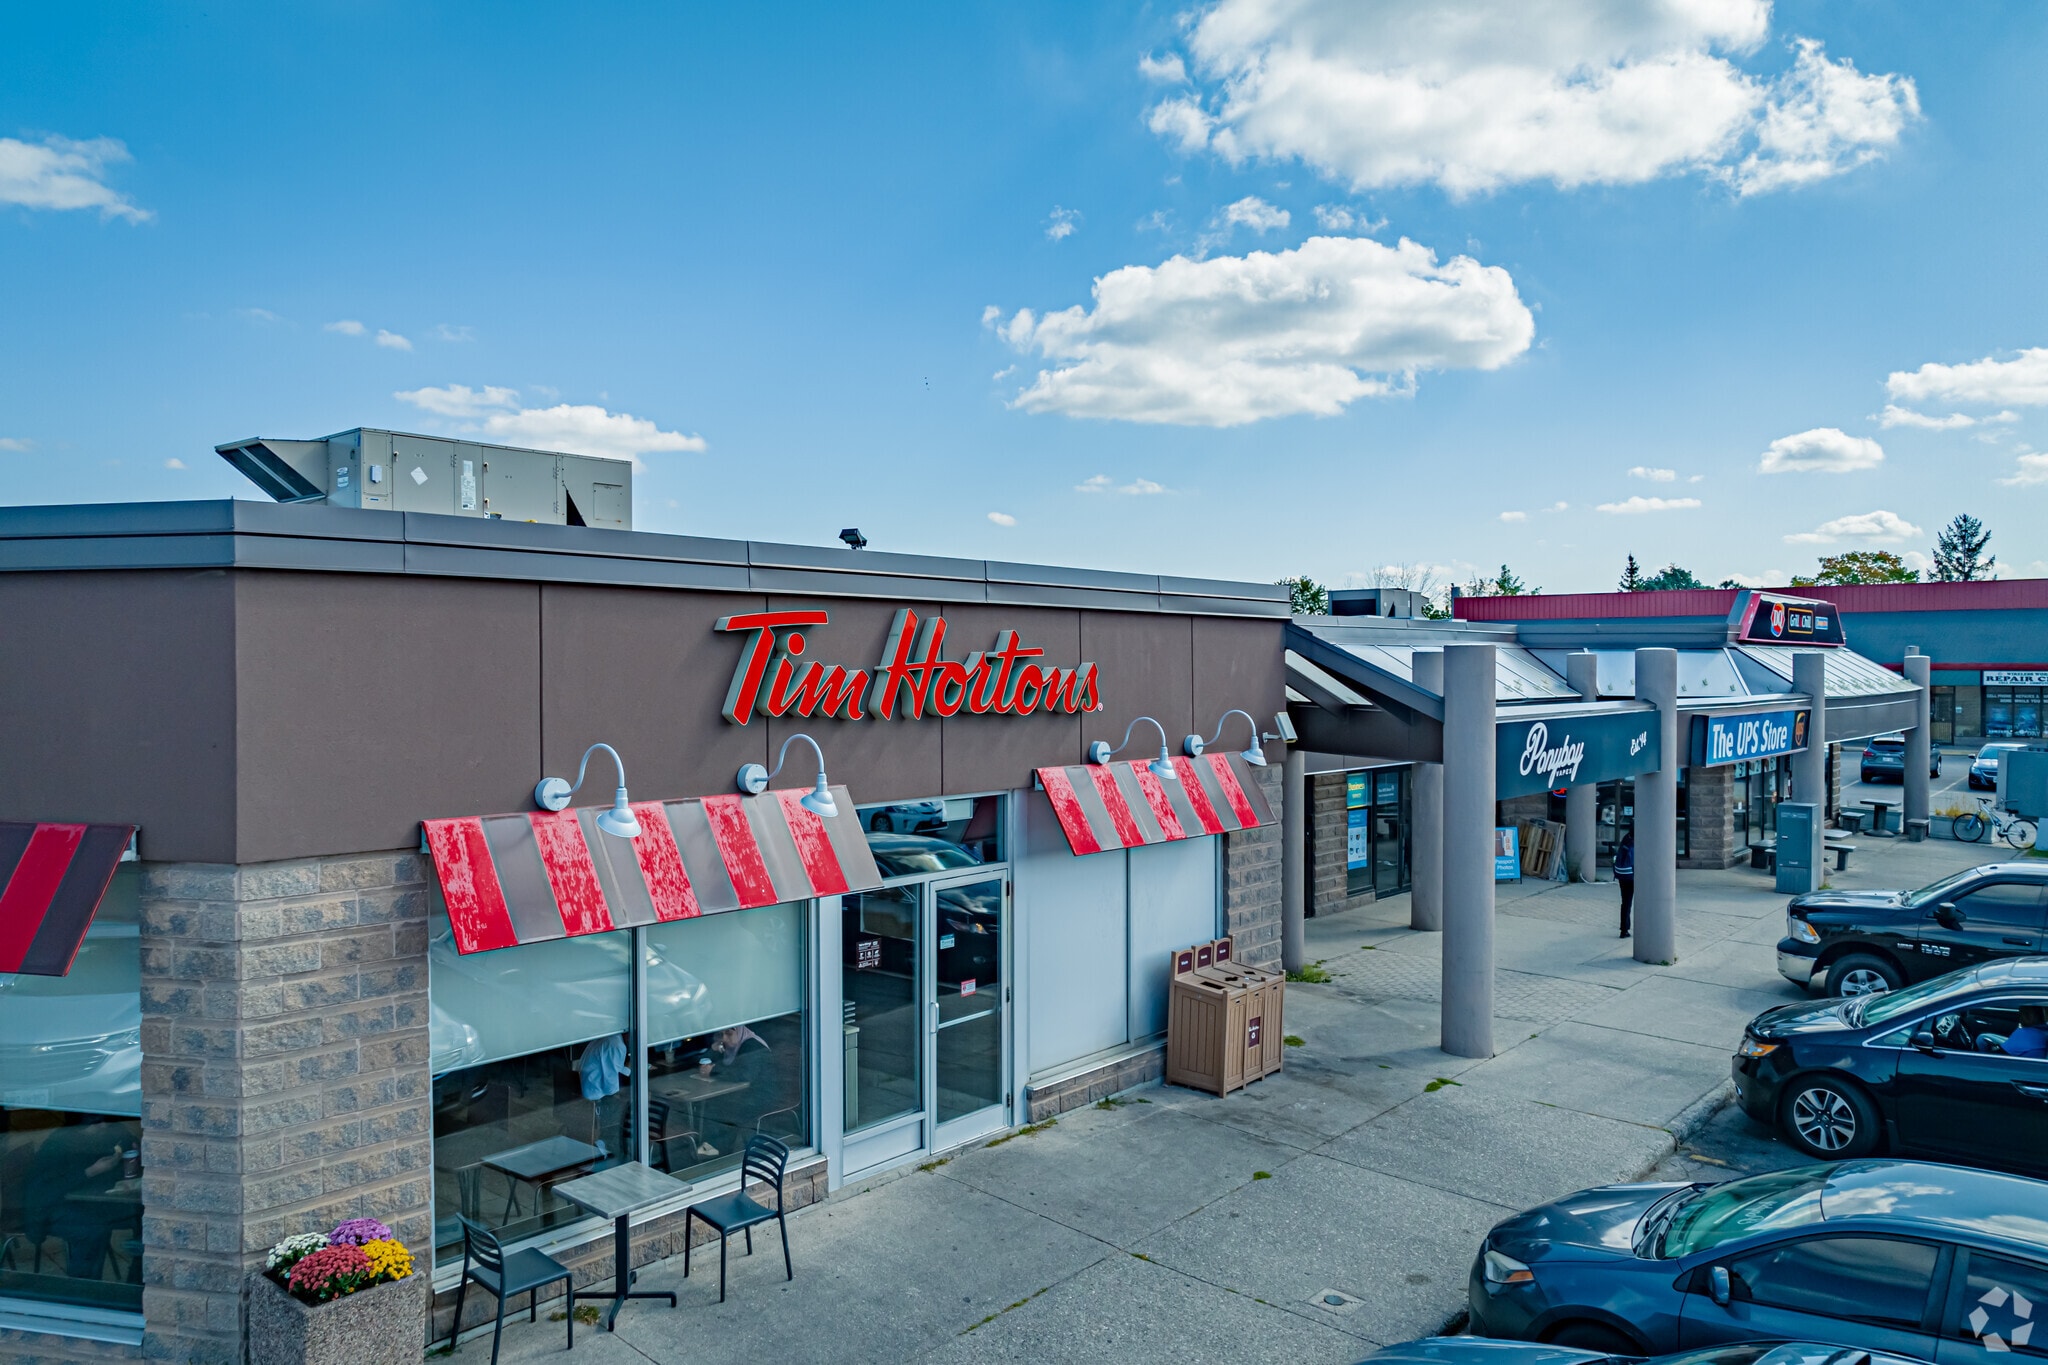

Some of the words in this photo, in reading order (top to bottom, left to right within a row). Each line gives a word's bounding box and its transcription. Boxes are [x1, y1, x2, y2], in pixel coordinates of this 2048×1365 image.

[713, 609, 870, 727] Tim
[867, 607, 1100, 722] Hortons
[1519, 722, 1585, 789] Ponyboy
[1712, 723, 1734, 760] The
[1736, 720, 1759, 756] UPS
[1760, 719, 1788, 753] Store
[1556, 767, 1573, 777] VAPES
